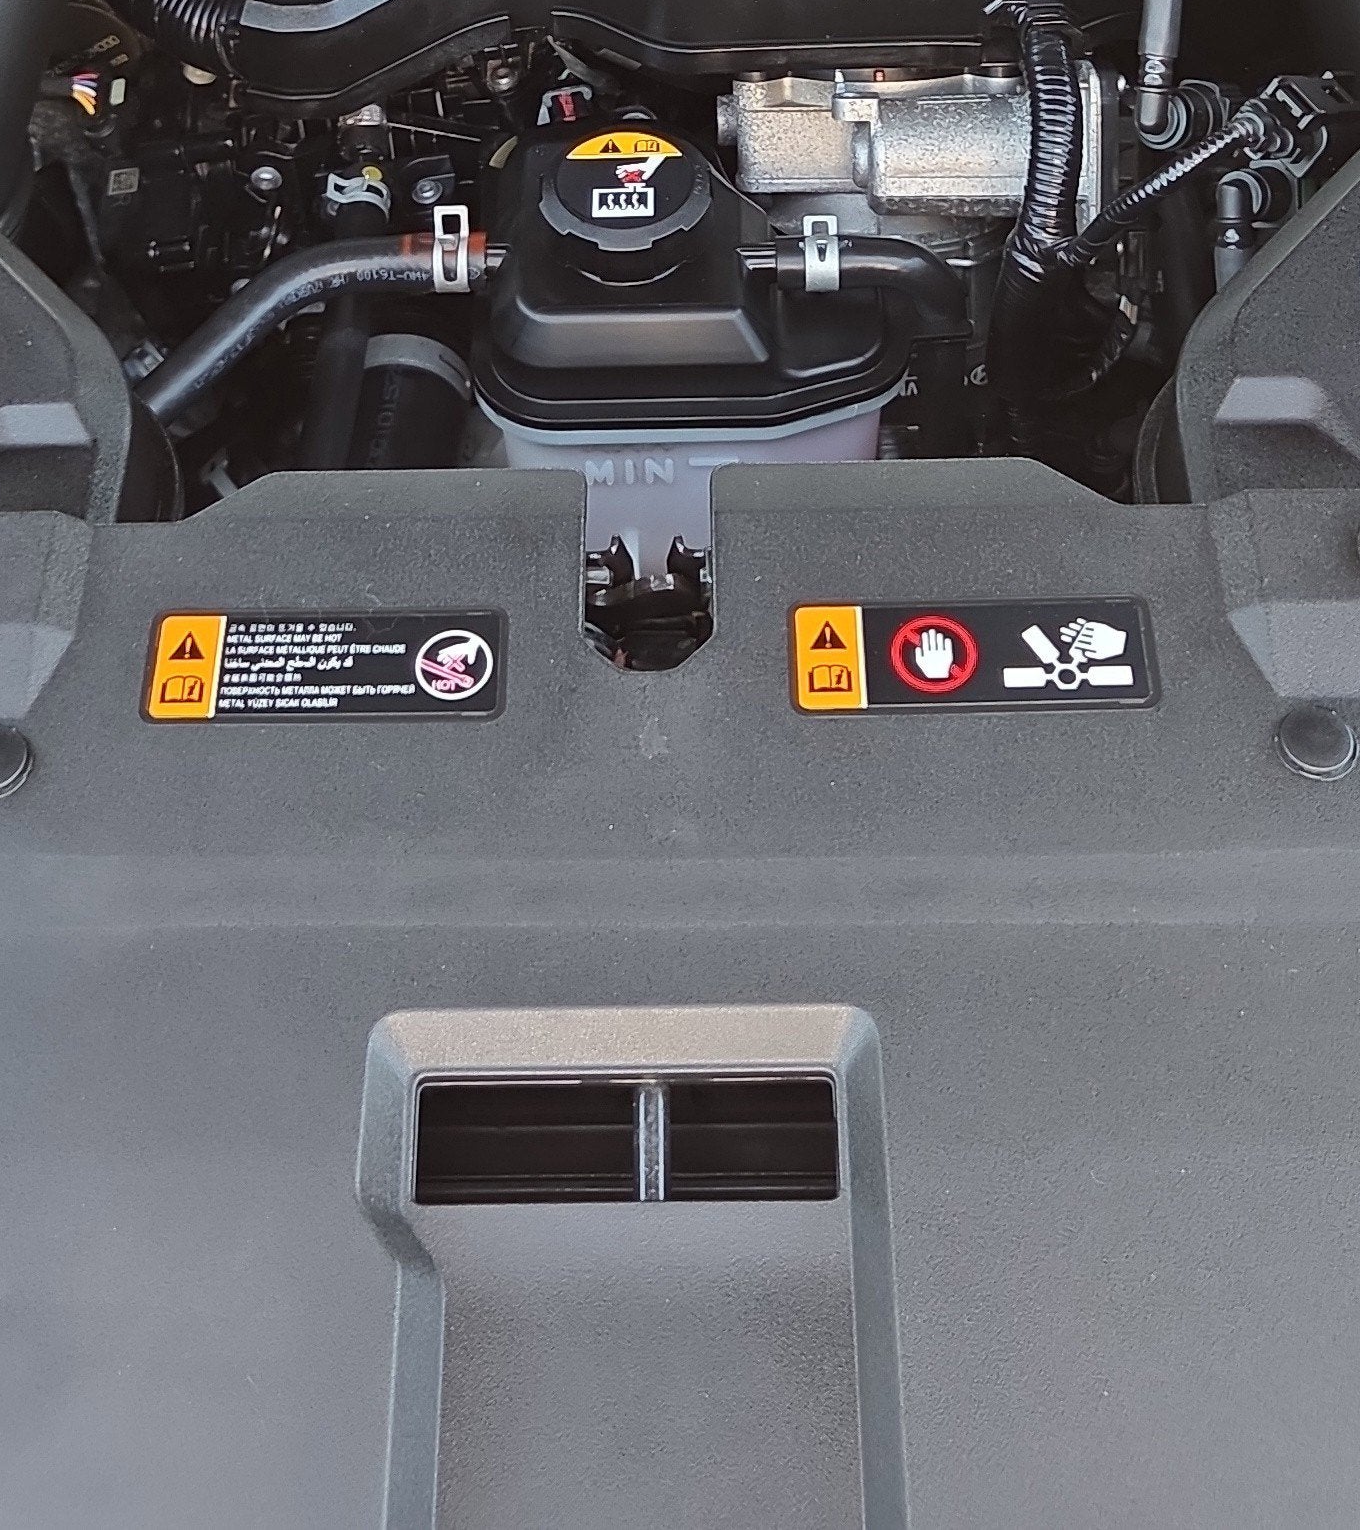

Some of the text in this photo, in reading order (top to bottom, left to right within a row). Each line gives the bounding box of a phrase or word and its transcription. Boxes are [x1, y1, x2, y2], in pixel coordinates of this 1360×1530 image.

[585, 457, 674, 486] MIN
[226, 633, 343, 644] METAL SURFACE MAY BE HOT
[225, 644, 236, 654] LA
[237, 644, 275, 654] SURFACE
[326, 643, 349, 654] PEUT
[349, 642, 372, 654] ÊTRE
[372, 643, 407, 654] CHAUDE
[220, 685, 281, 696] ПОВЕРХНОСТЬ
[320, 684, 352, 695] МОЖЕТ
[352, 684, 377, 696] БЫТЬ
[377, 683, 416, 695] ГОРЯЧЕЙ
[431, 679, 456, 691] HOT
[218, 698, 245, 708] METAL
[247, 697, 274, 708] YÜZEY
[275, 698, 300, 708] SICAK
